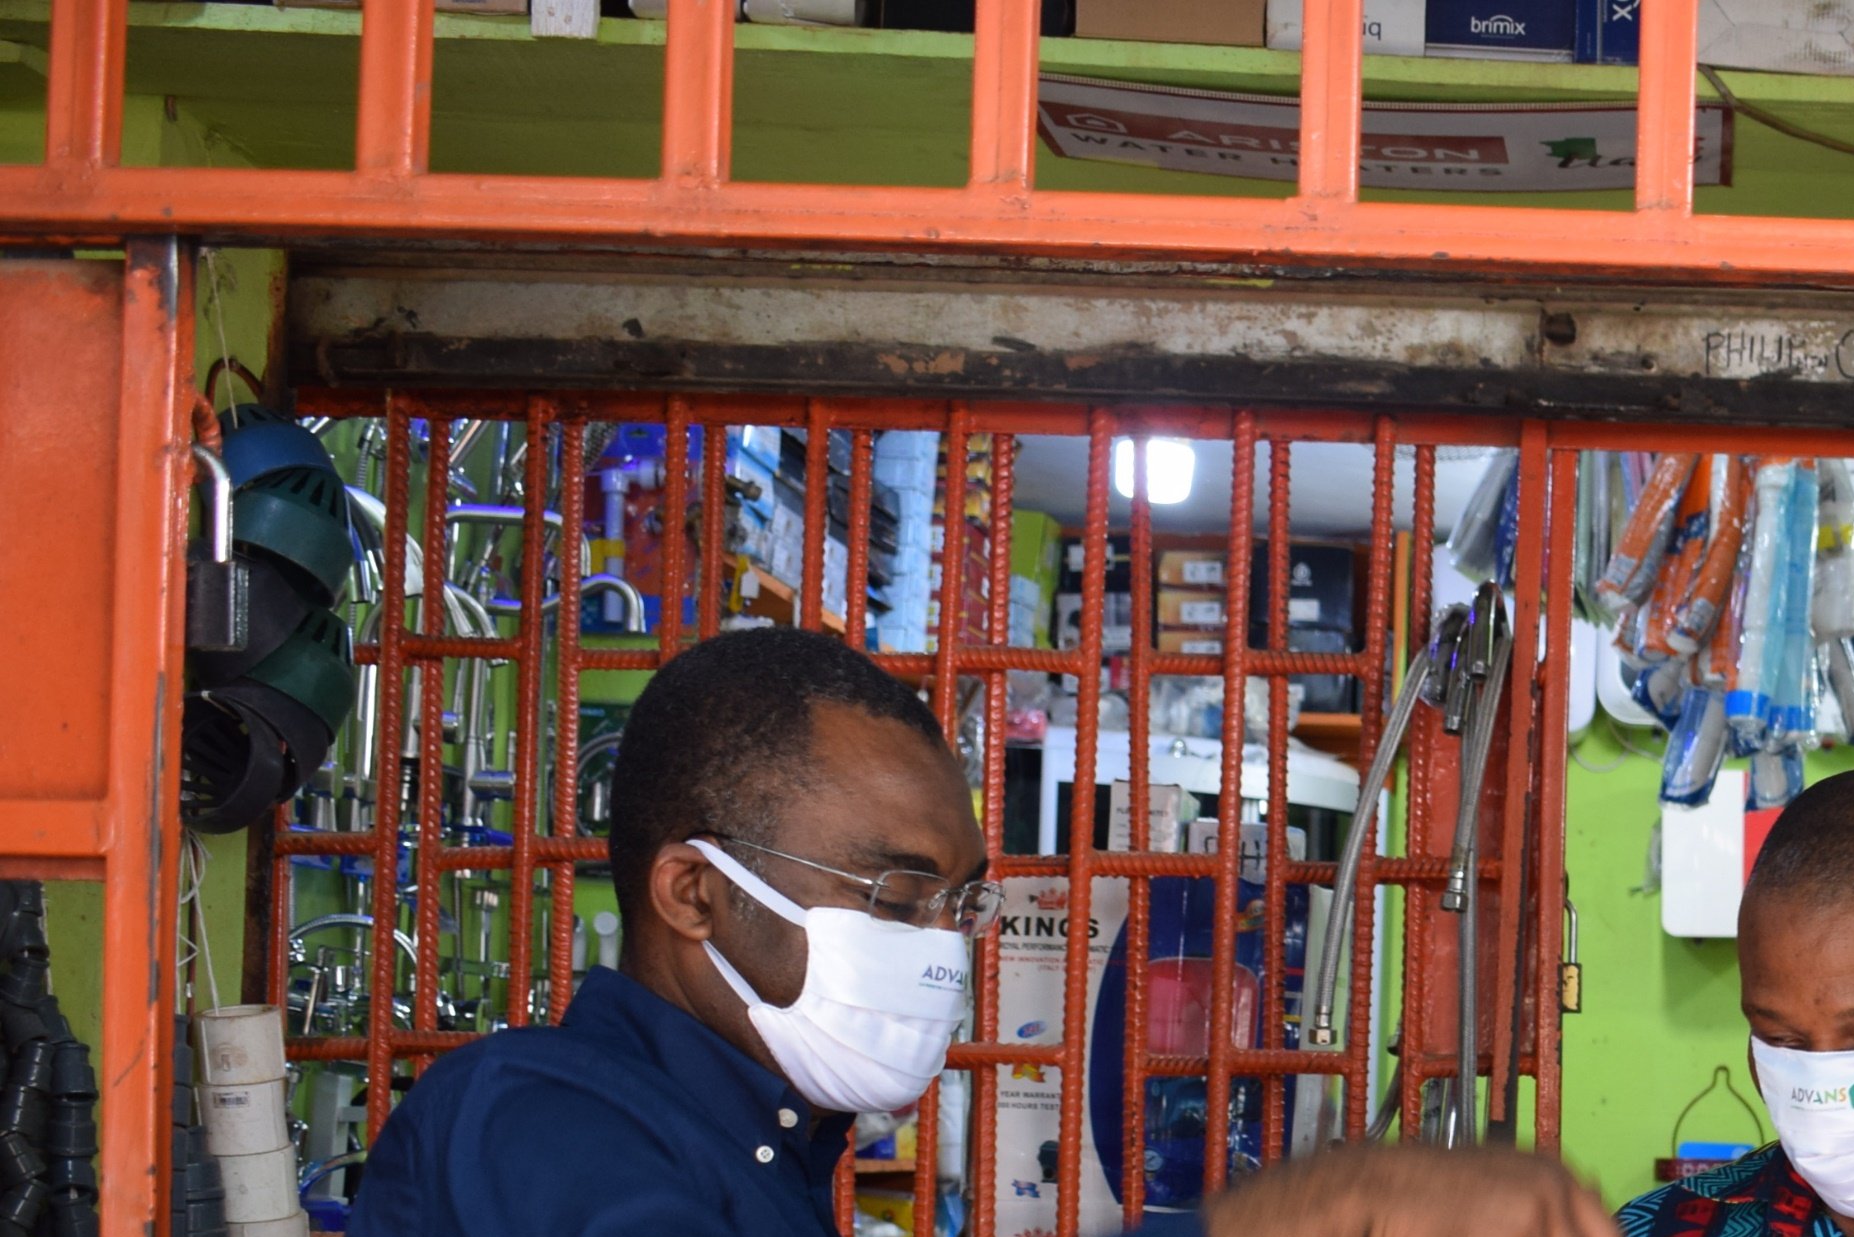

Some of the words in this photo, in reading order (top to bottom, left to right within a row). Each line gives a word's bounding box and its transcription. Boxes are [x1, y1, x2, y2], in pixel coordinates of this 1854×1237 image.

[1470, 15, 1526, 36] brimix
[1070, 132, 1243, 161] WATER
[1270, 155, 1503, 176] HTERS
[1168, 129, 1480, 162] ARION
[922, 965, 964, 985] ADVA
[1023, 1091, 1060, 1100] WARRANT
[1791, 1087, 1847, 1104] ADVANS
